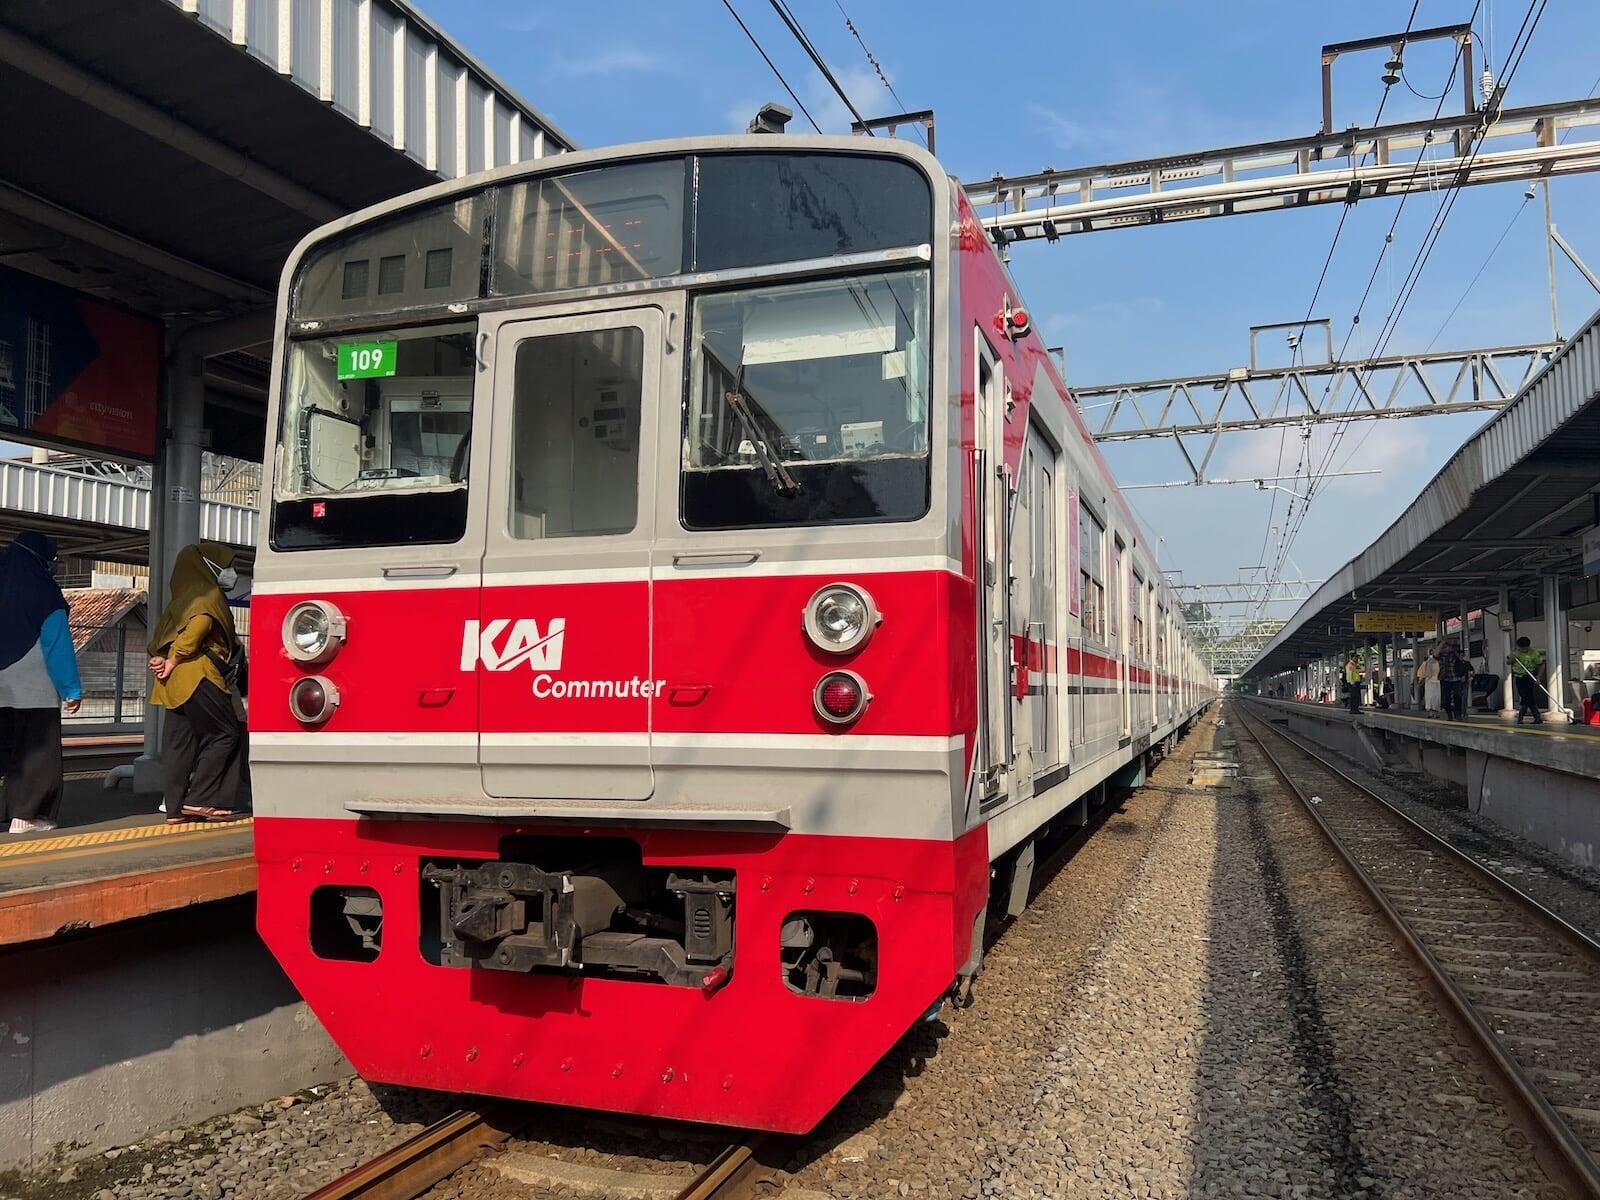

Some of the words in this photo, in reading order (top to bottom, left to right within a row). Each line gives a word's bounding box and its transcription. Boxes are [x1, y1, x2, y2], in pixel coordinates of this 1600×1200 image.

[351, 348, 383, 371] 109
[89, 401, 133, 419] cityvision
[460, 618, 566, 672] KAI
[532, 673, 667, 698] Commuter
